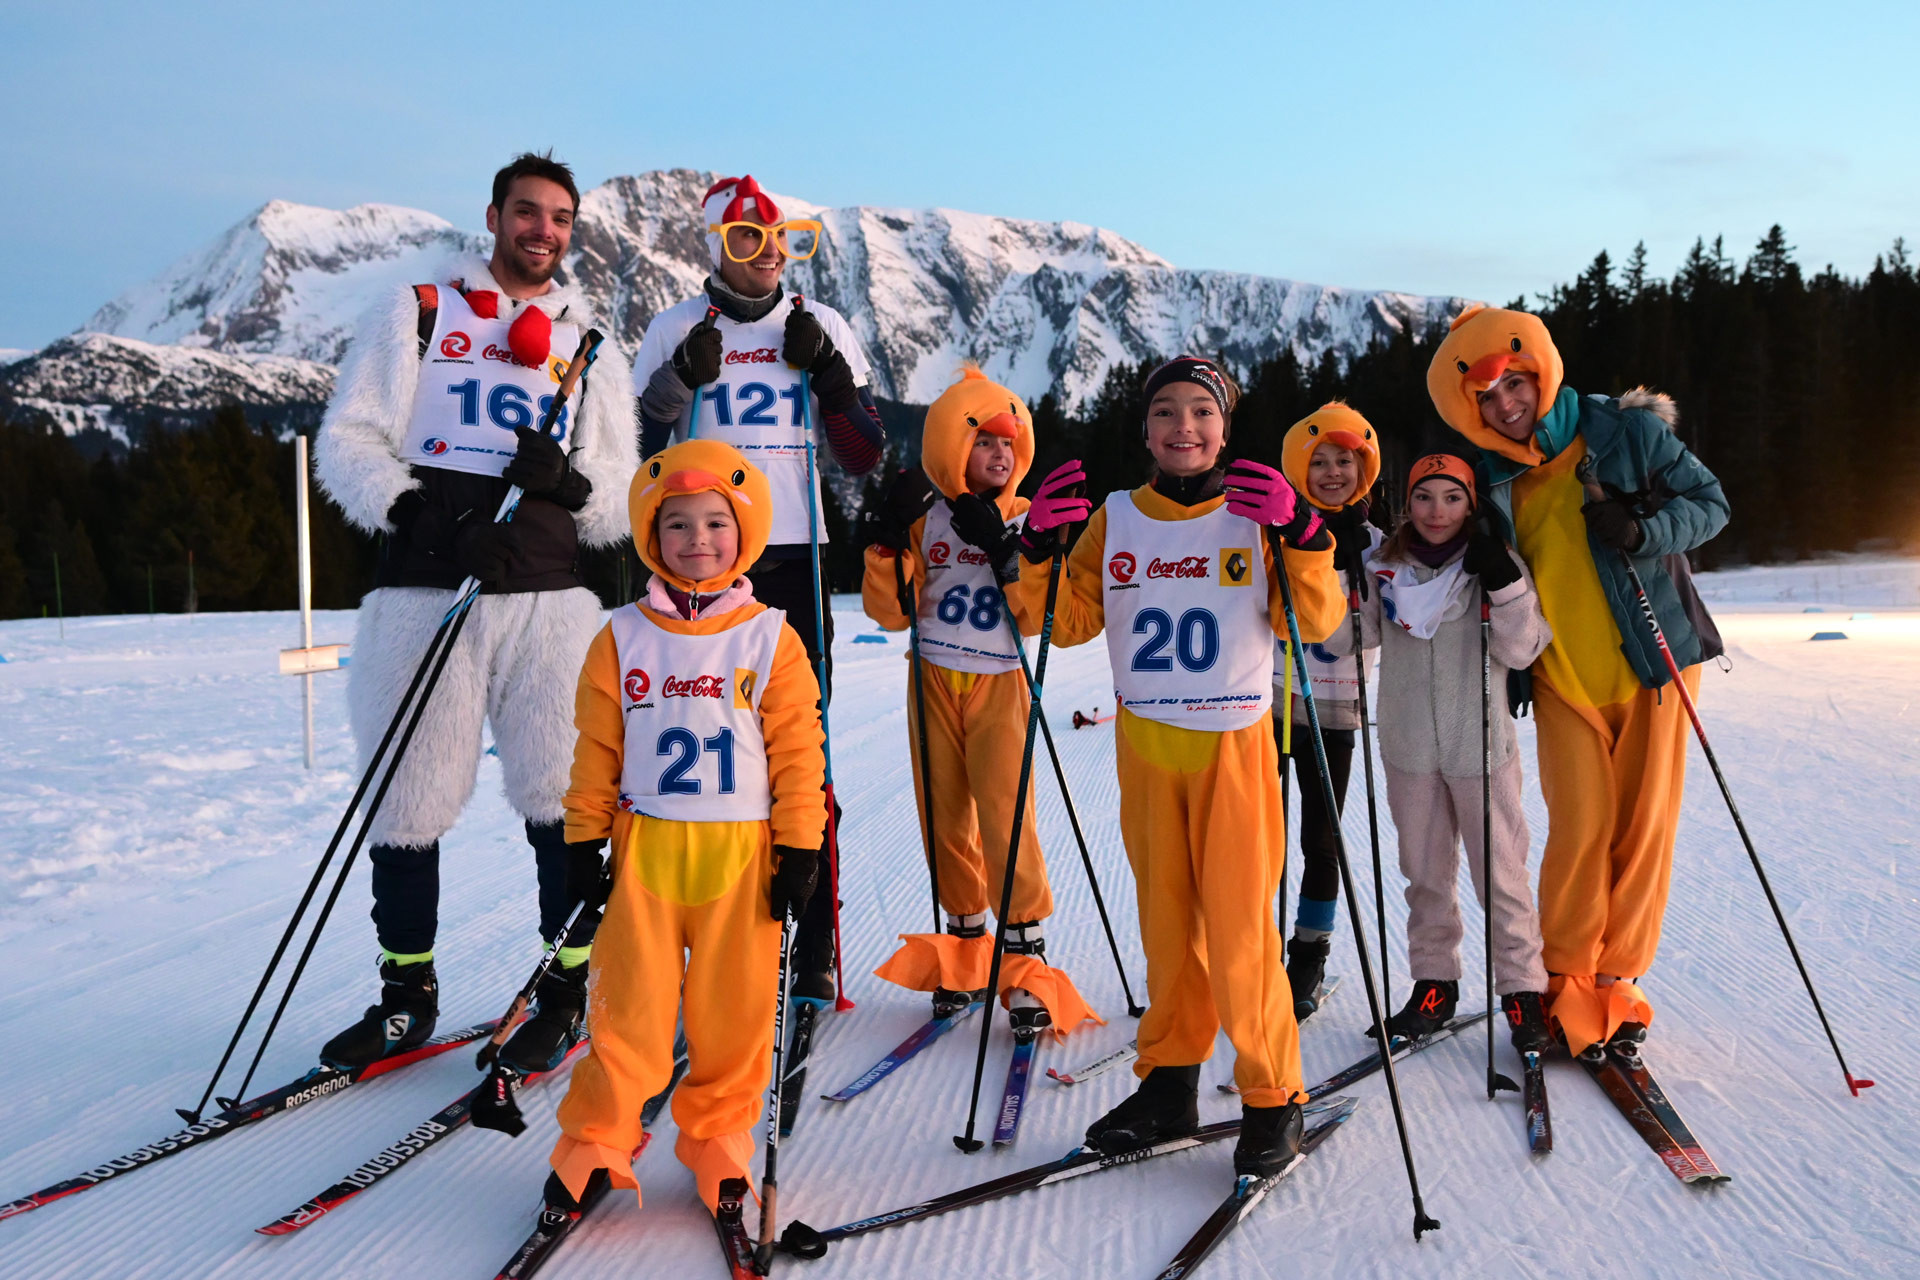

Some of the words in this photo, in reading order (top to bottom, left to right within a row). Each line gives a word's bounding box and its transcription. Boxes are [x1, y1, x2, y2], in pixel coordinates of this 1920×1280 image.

[447, 378, 569, 444] 168
[702, 381, 804, 427] 121
[936, 583, 1001, 632] 68
[1130, 607, 1220, 673] 20
[656, 726, 736, 796] 21
[286, 1073, 353, 1109] ROSSIGNOL
[849, 1060, 894, 1091] SALOMON
[999, 1094, 1021, 1130] SALOMON
[79, 1116, 229, 1184] ROSSIGNOL
[346, 1120, 448, 1189] ROSSIGNOL
[1099, 1148, 1153, 1169] salomon
[842, 1204, 928, 1232] salomon
